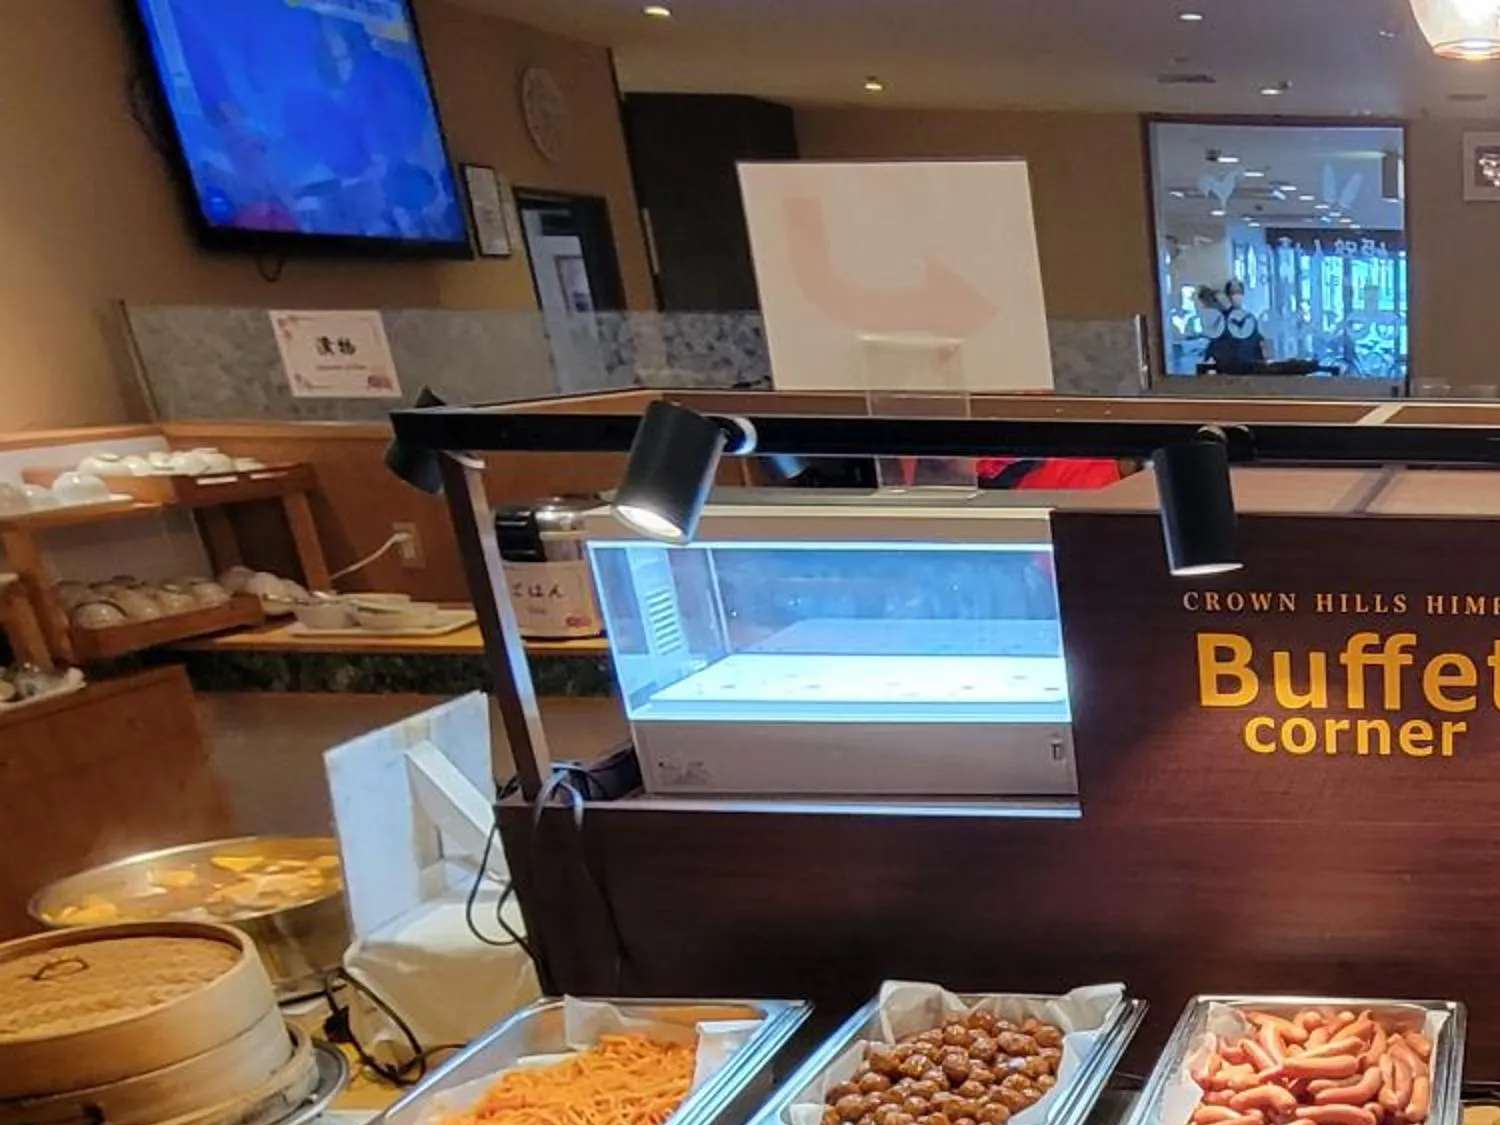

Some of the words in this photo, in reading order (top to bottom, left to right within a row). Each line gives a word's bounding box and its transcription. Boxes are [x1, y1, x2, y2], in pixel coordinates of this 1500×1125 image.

[1183, 591, 1296, 612] CROWN
[1315, 593, 1407, 613] HILLS
[1244, 716, 1467, 756] corner
